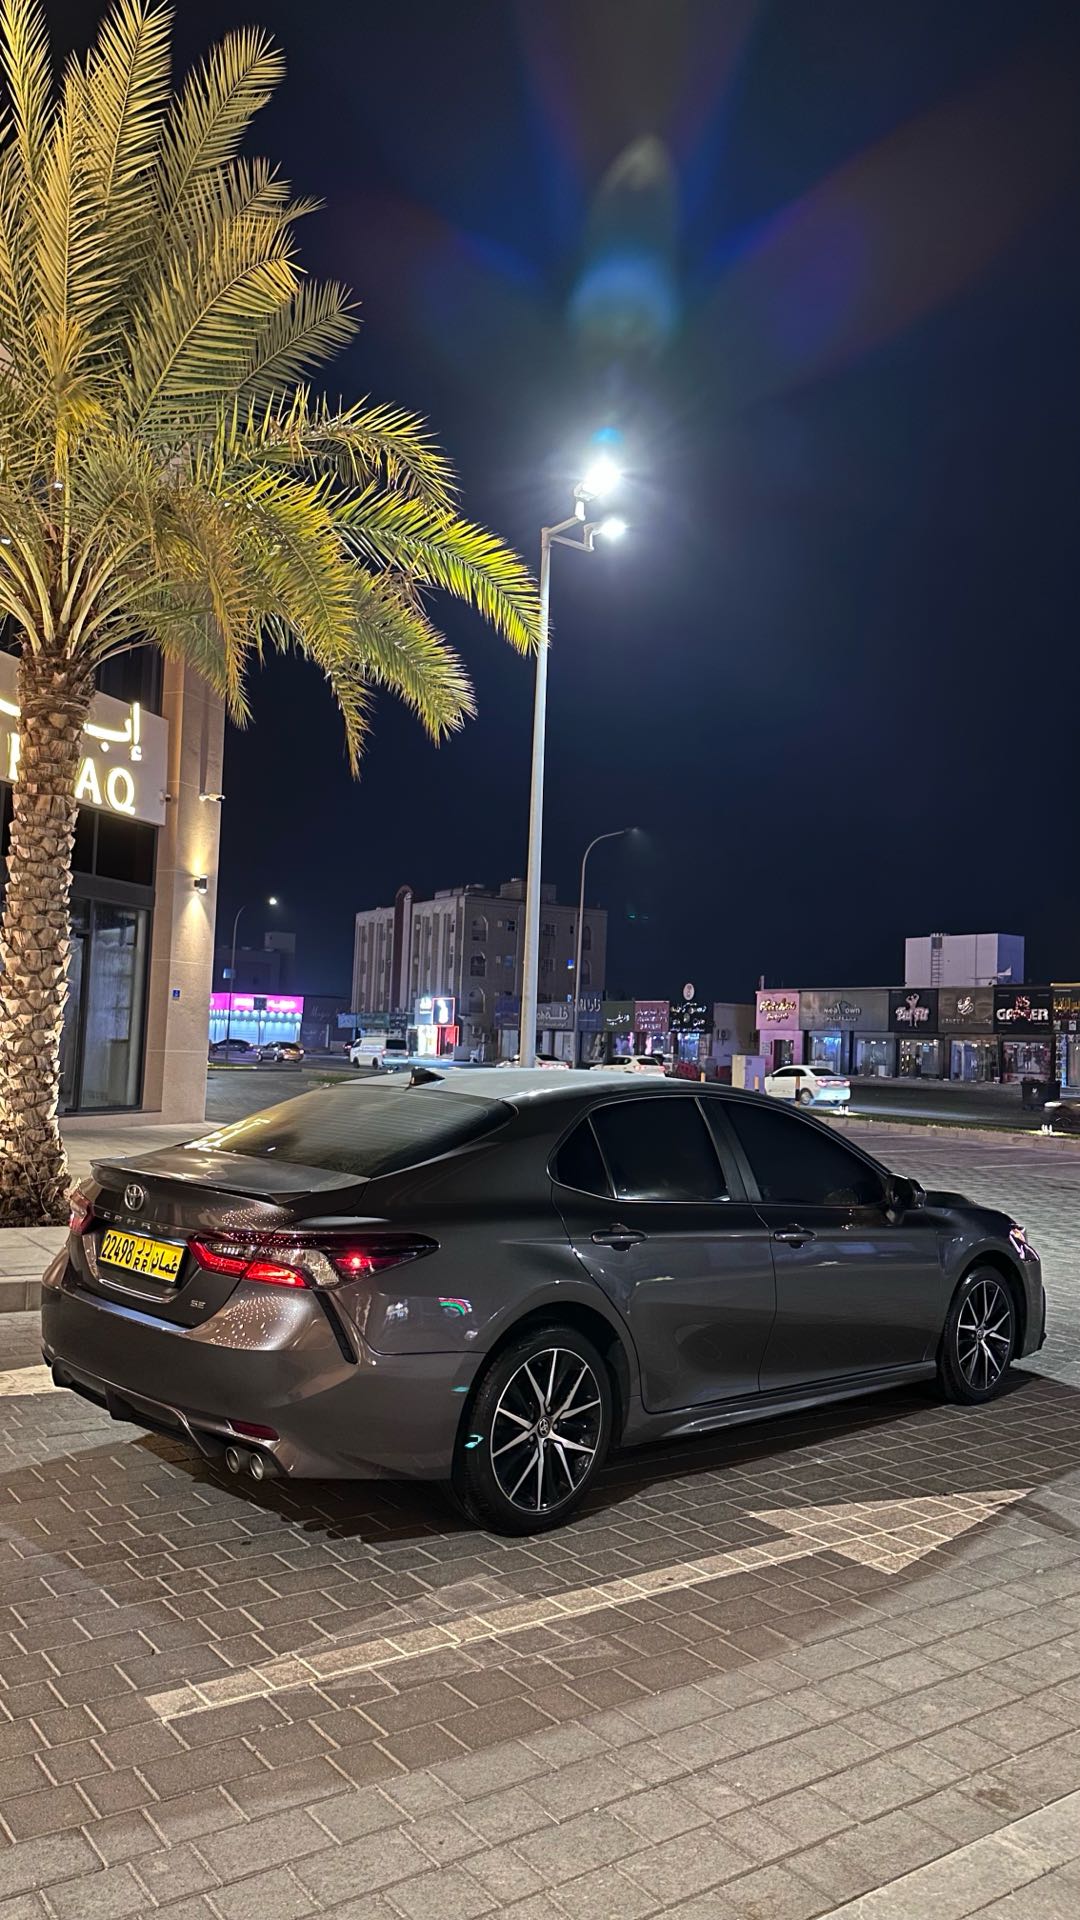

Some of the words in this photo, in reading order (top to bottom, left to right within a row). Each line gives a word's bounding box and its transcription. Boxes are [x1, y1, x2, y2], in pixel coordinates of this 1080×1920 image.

[103, 1211, 168, 1232] CAMRY
[101, 1234, 135, 1265] 22498
[190, 1299, 206, 1309] SE
